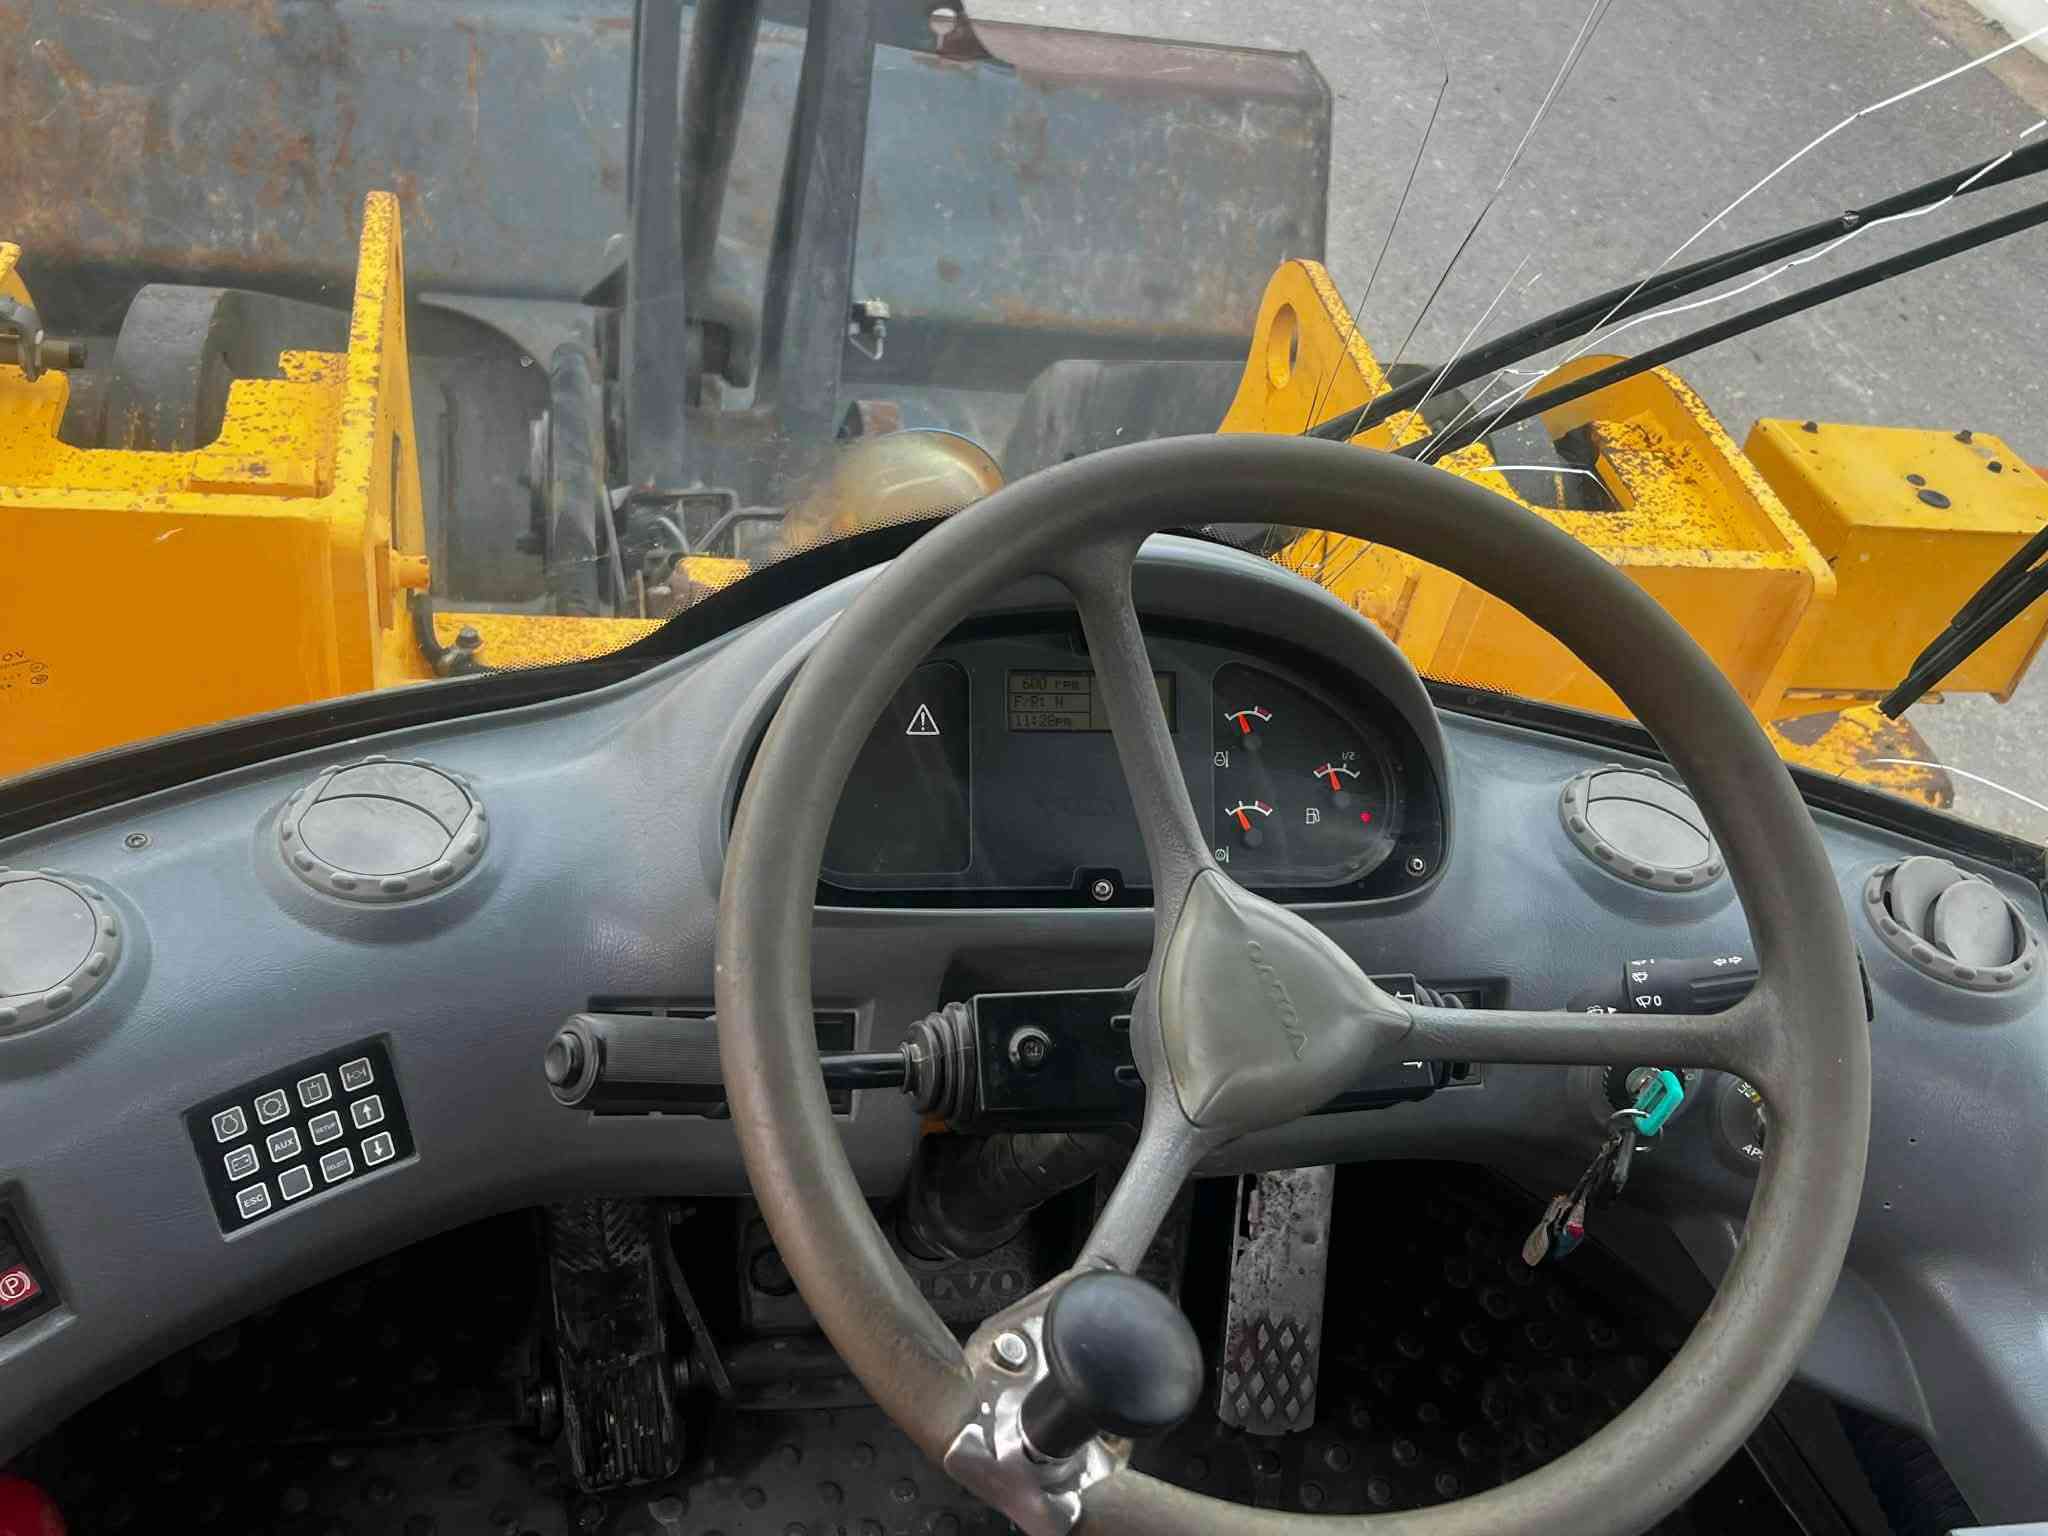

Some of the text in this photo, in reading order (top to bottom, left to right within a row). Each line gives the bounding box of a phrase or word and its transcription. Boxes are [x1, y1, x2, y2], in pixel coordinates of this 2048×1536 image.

[273, 1138, 295, 1152] AUX
[243, 1193, 264, 1208] ESC
[917, 1270, 1026, 1301] LVO
